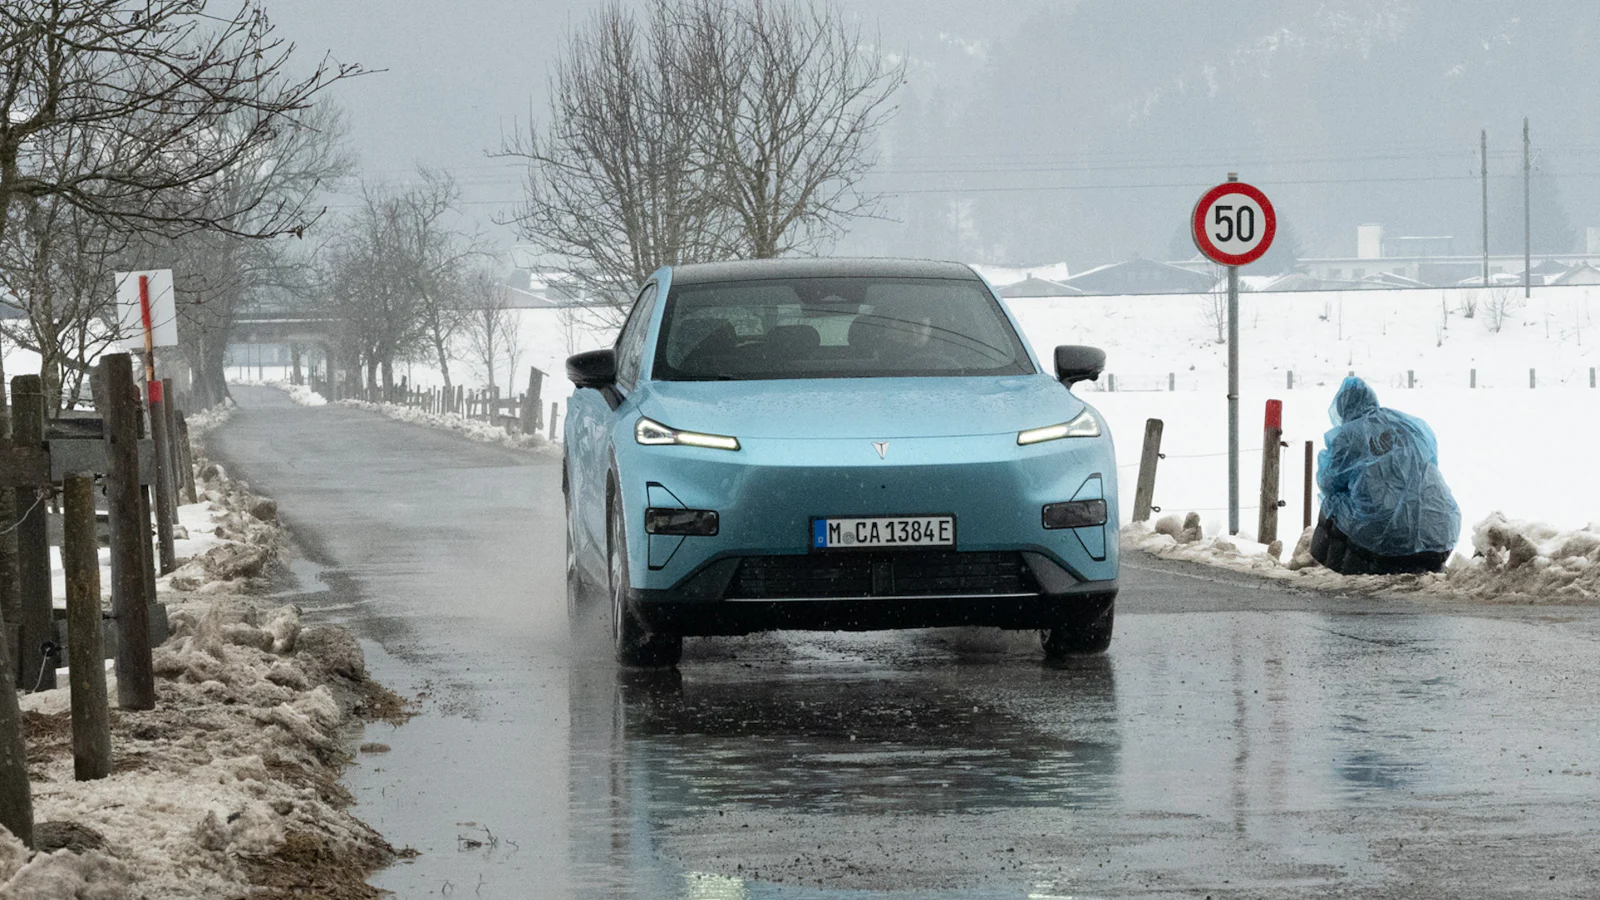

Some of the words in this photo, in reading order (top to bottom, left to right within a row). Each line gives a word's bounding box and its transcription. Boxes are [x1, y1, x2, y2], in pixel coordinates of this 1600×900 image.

[1215, 205, 1254, 242] 50
[828, 522, 841, 544] M
[855, 521, 881, 543] CA
